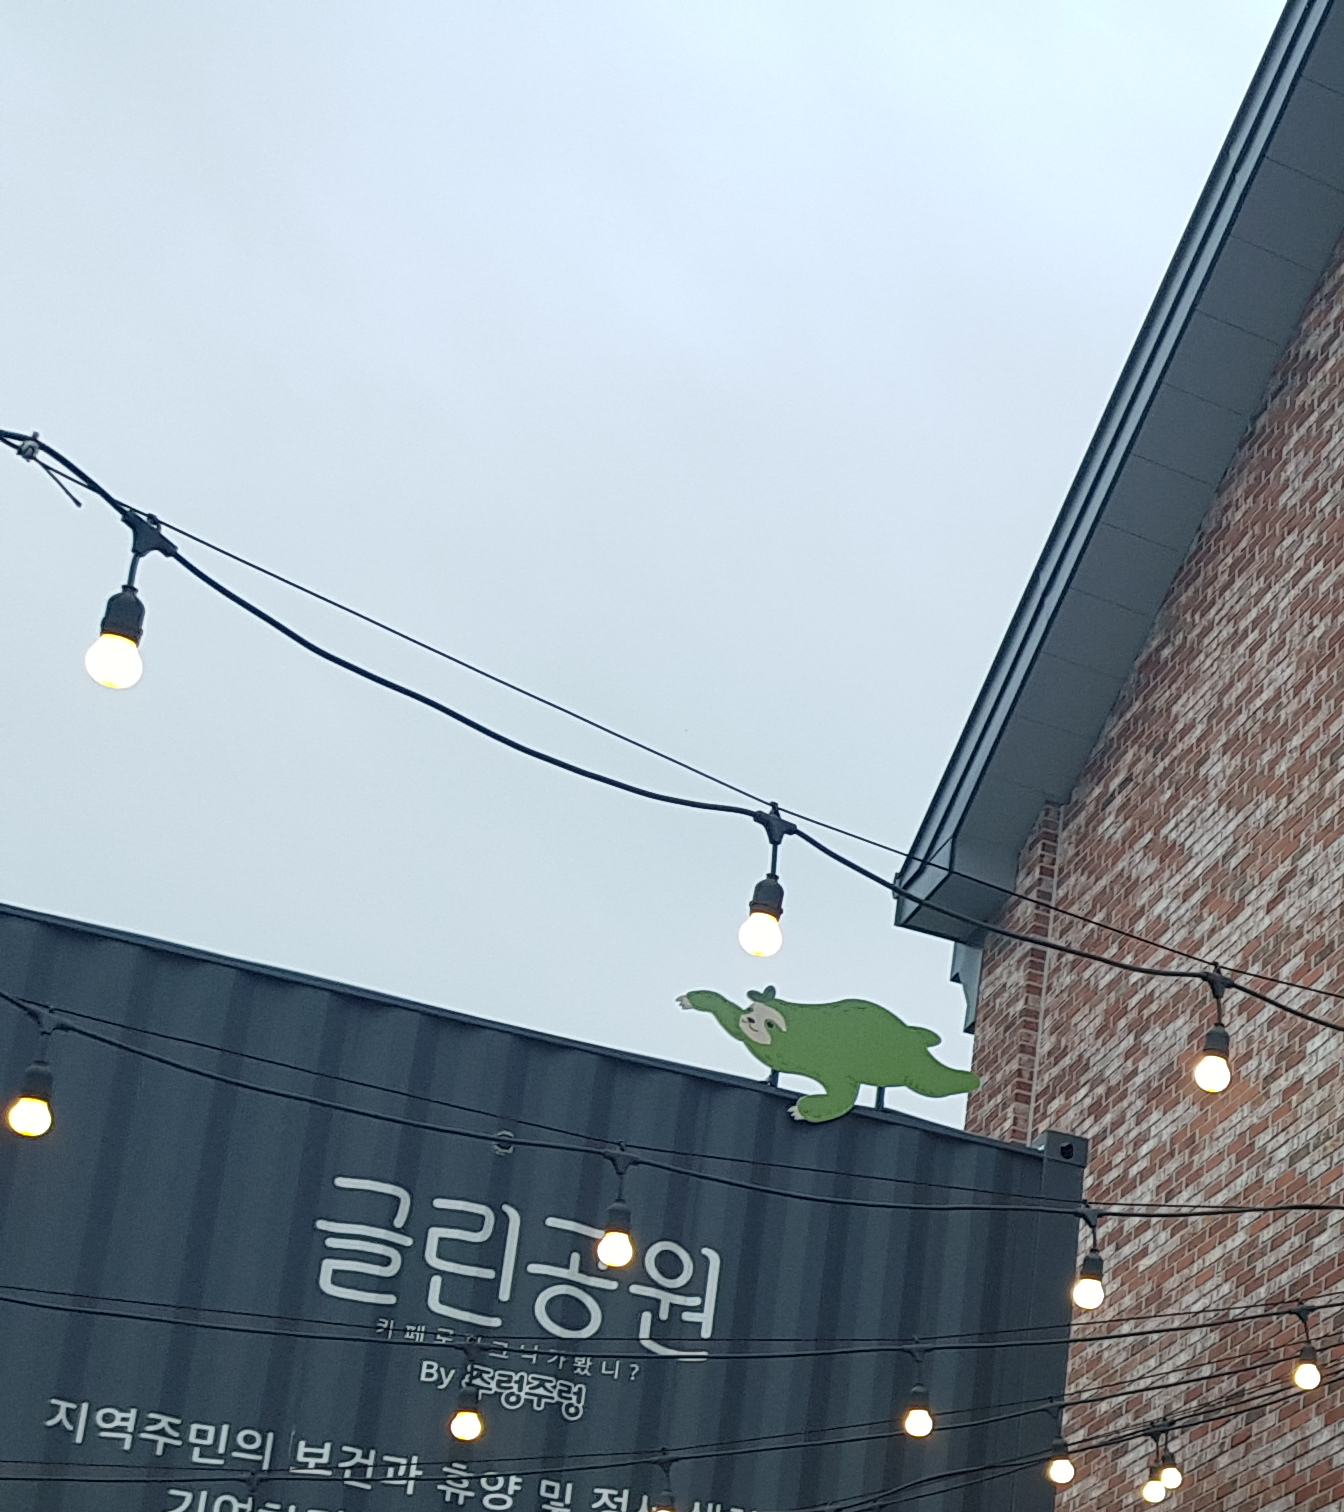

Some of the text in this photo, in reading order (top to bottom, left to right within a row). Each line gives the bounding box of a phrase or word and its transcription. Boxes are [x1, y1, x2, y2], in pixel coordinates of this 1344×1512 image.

[316, 1175, 721, 1362] 글린공원
[419, 1360, 588, 1422] By 주렁주렁
[43, 1397, 275, 1470] 지역주민의
[289, 1438, 423, 1496] 보건과
[436, 1462, 523, 1511] 휴양
